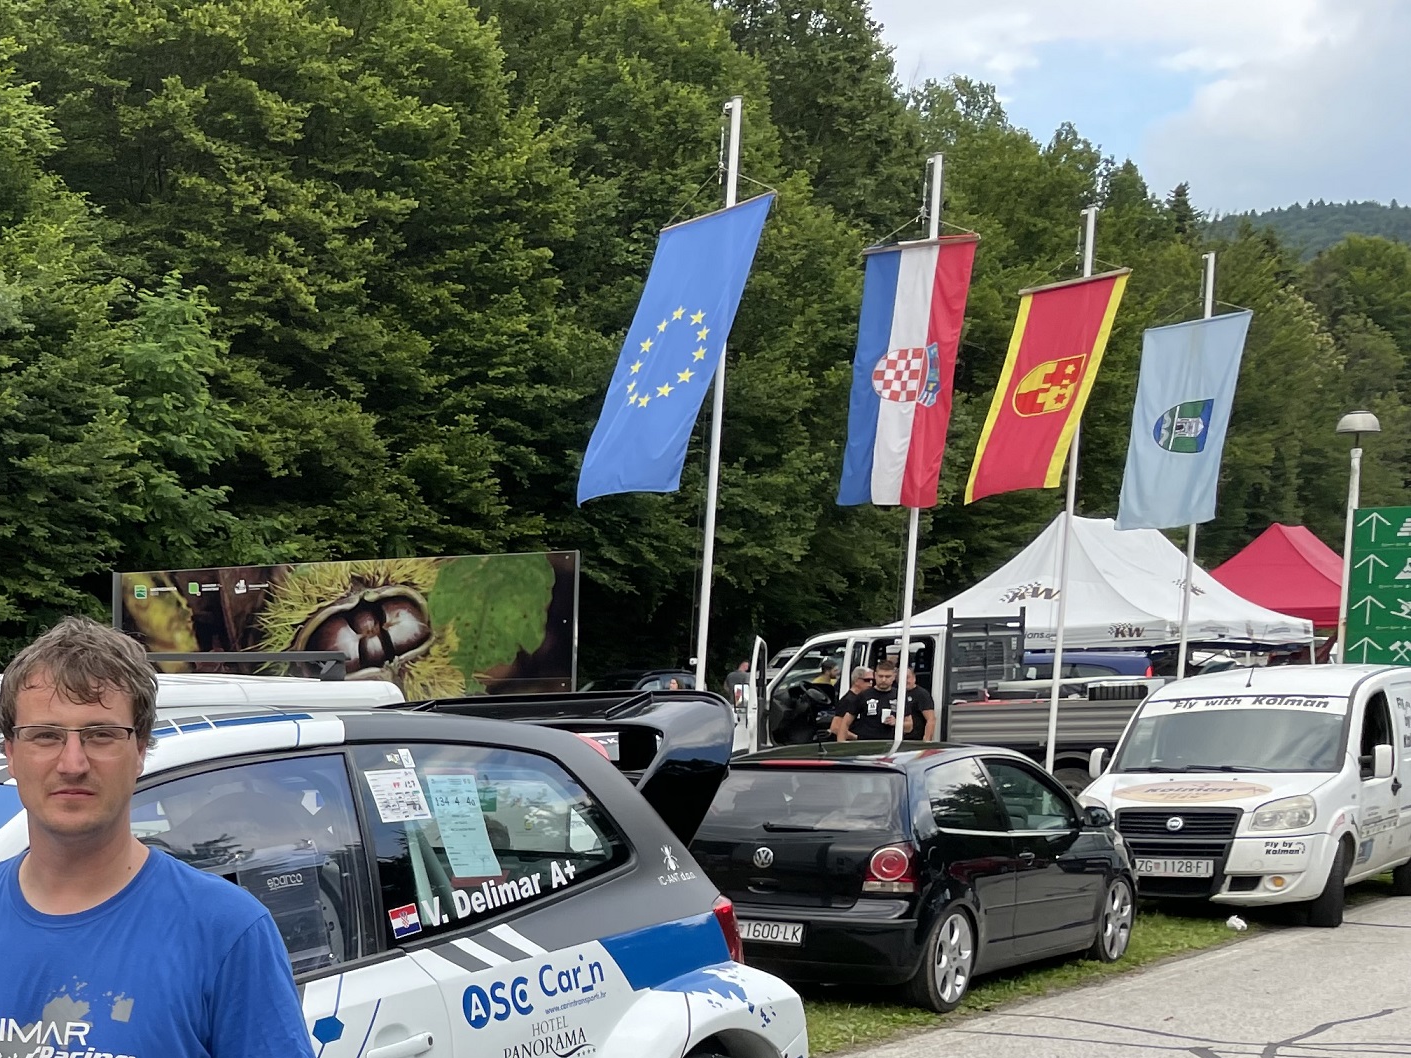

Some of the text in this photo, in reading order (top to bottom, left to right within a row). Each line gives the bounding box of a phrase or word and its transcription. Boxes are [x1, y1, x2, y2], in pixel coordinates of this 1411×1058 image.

[1173, 696, 1330, 710] Fly with Kolman
[1137, 860, 1153, 872] ZG
[266, 872, 304, 890] sparco
[420, 859, 577, 927] V. Delimar A+
[462, 975, 534, 1030] ASC
[531, 1015, 569, 1037] HOTEL
